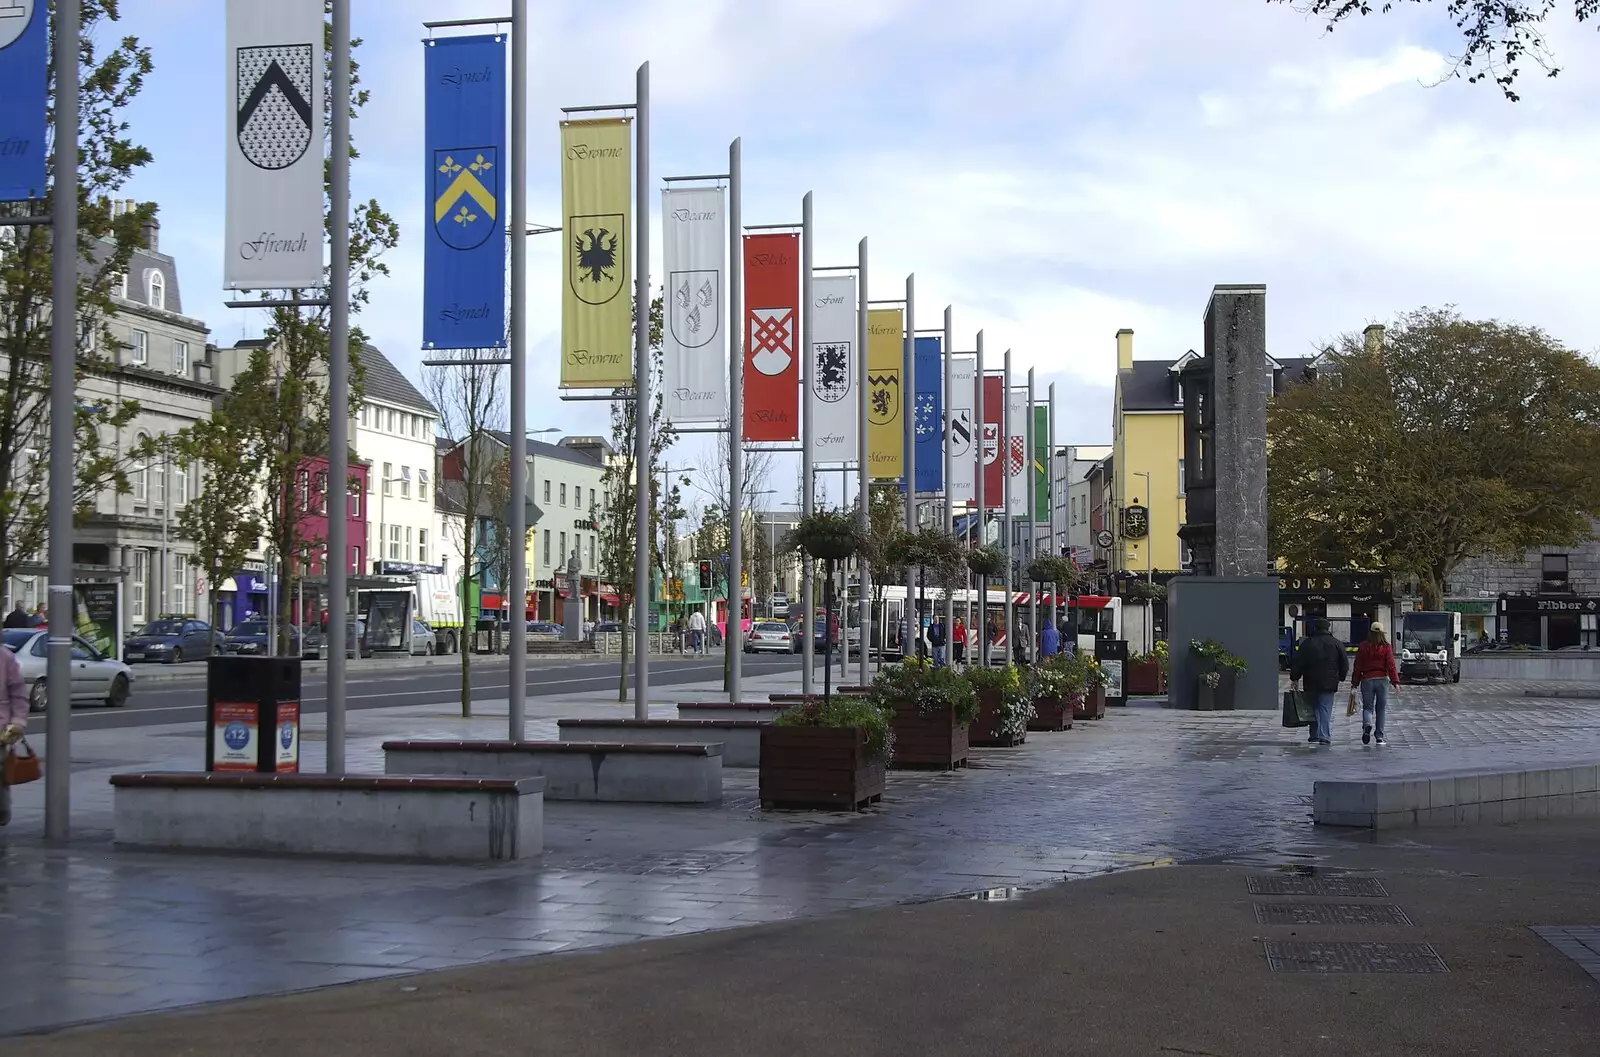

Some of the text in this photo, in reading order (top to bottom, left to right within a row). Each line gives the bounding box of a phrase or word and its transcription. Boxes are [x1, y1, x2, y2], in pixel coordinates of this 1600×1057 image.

[440, 64, 491, 89] Lynch
[567, 144, 622, 160] Browne
[671, 208, 716, 222] Deane
[814, 294, 844, 308] Font
[438, 302, 490, 325] Lynch
[868, 325, 897, 335] Morris
[567, 350, 623, 365] Browne
[672, 388, 716, 401] Deane
[815, 433, 844, 447] Font
[868, 452, 897, 462] Morris
[1537, 601, 1581, 610] Fibber
